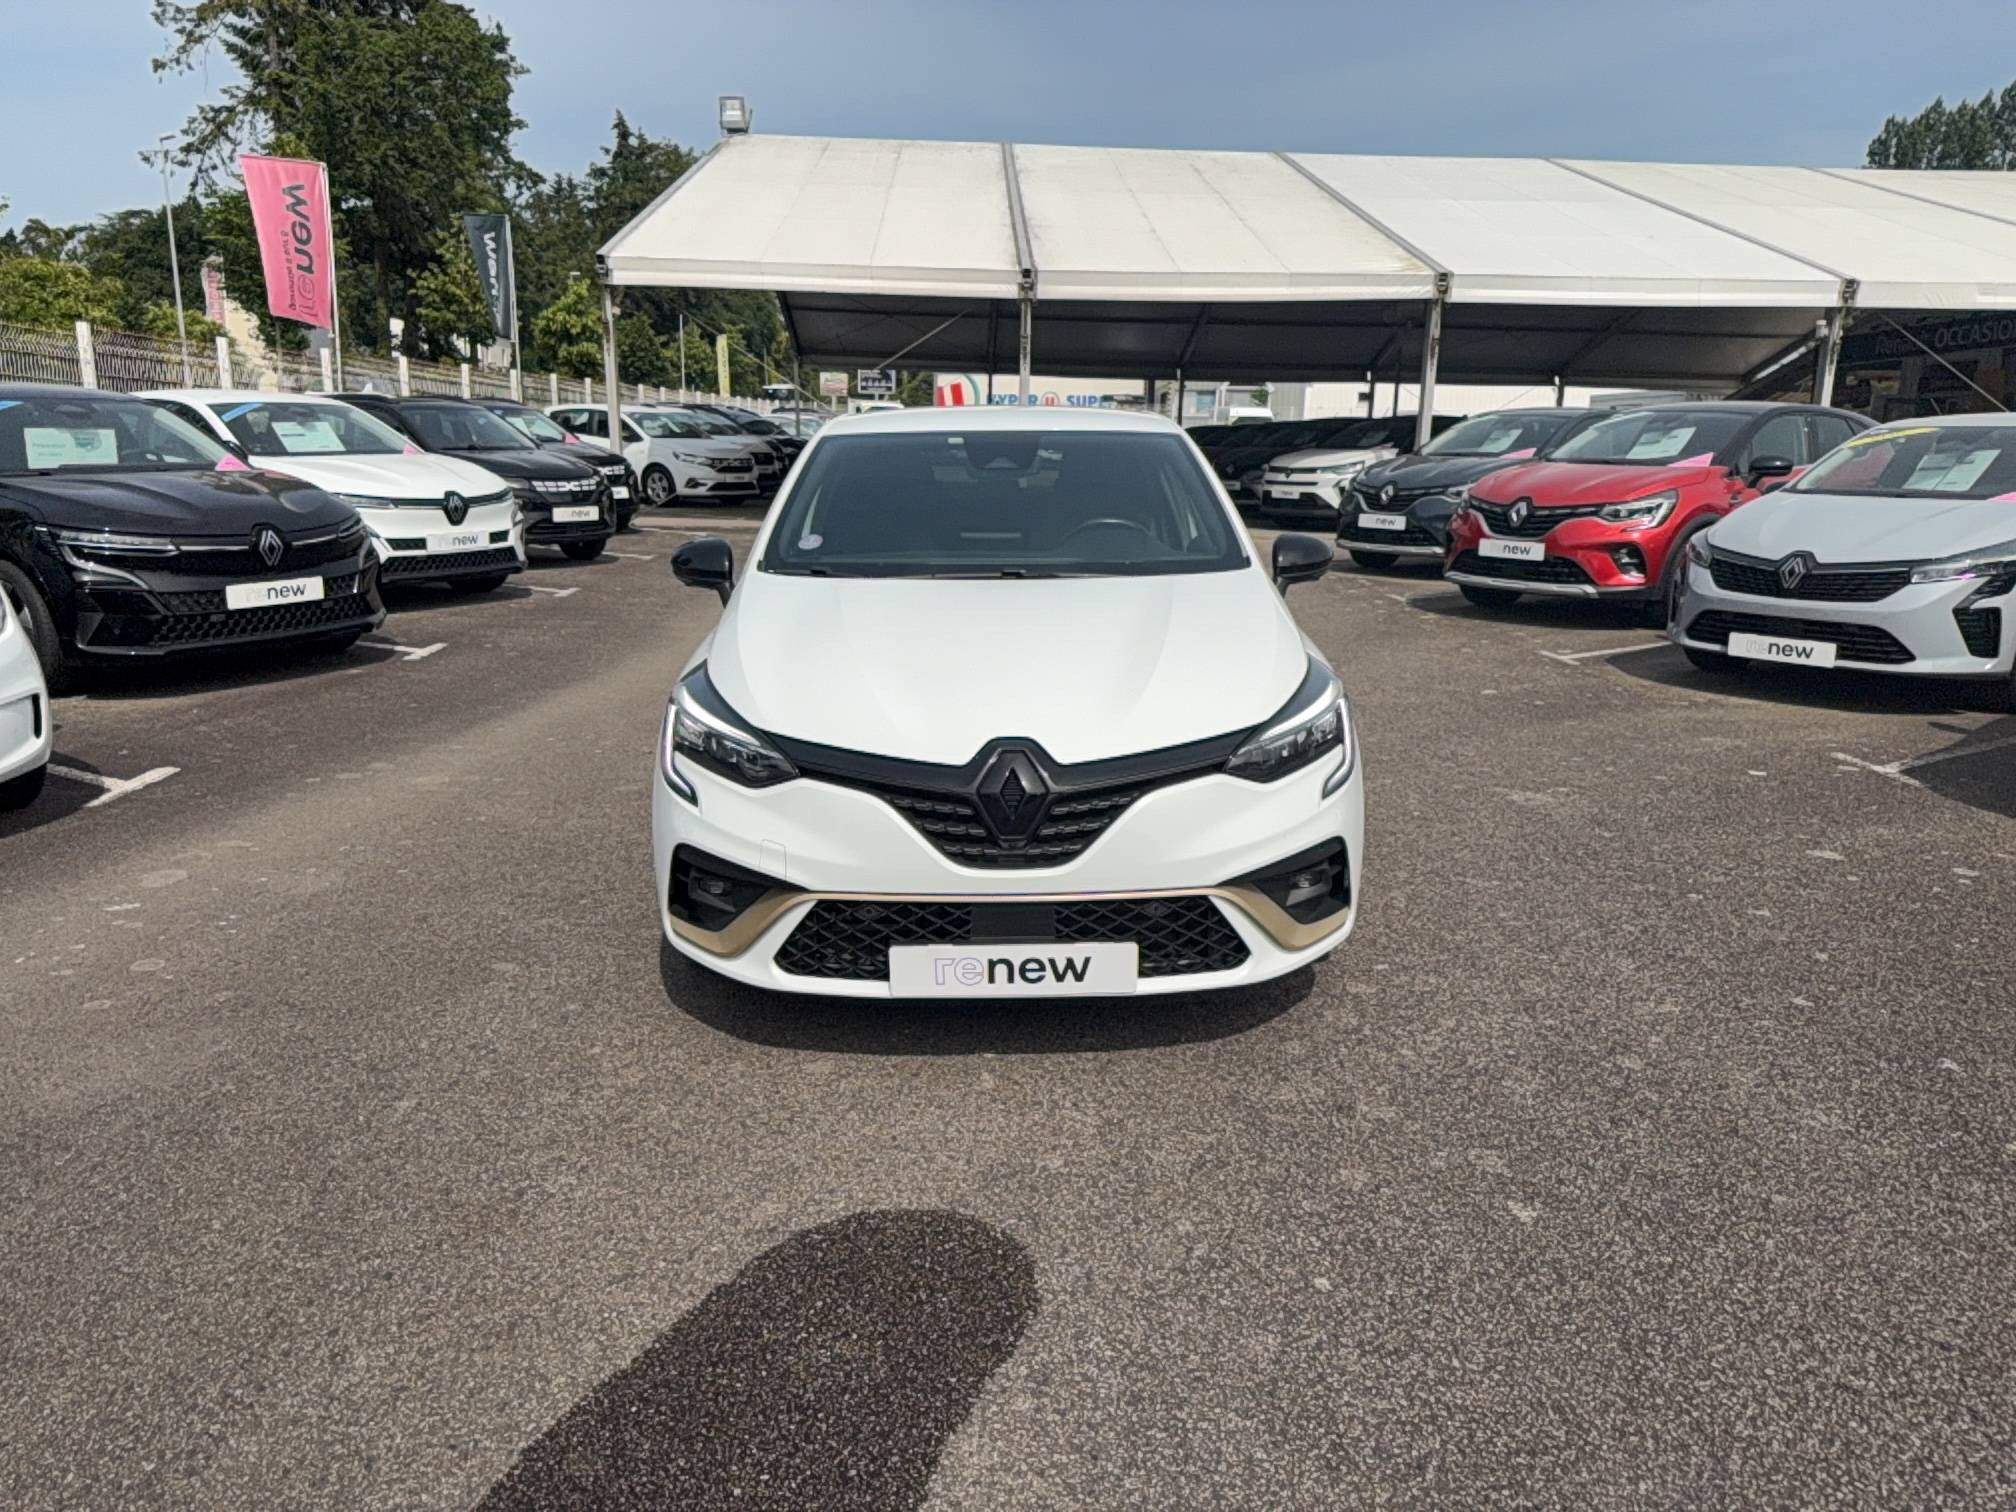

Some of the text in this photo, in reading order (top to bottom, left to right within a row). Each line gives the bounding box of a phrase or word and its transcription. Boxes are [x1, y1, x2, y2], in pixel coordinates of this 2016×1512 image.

[1934, 318, 2016, 348] OCCASIO
[987, 393, 1038, 406] HYPR
[934, 956, 1092, 986] renew
